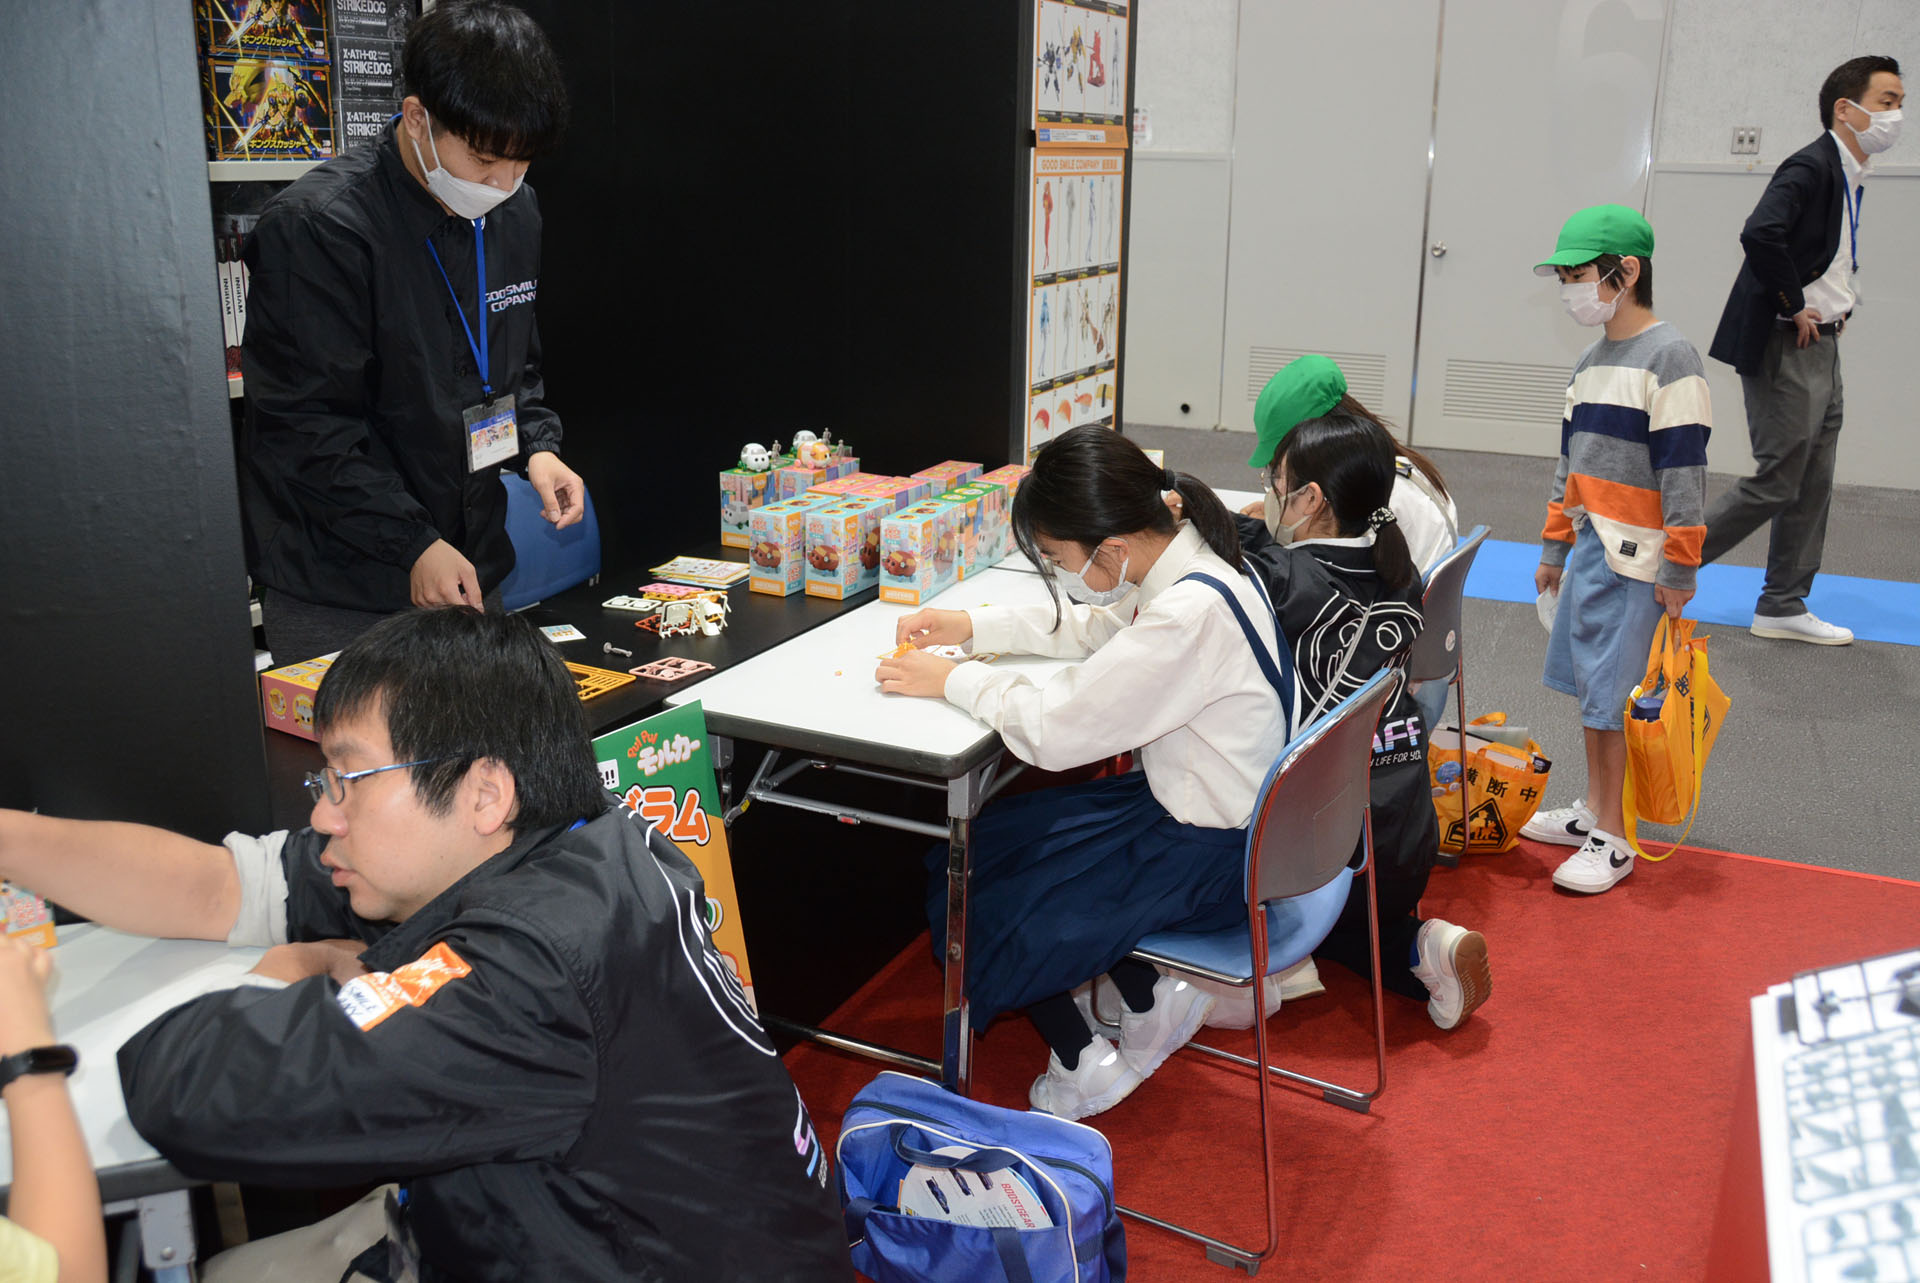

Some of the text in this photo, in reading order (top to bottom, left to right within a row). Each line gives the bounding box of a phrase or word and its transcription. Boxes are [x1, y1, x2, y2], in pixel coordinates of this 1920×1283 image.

[637, 733, 701, 777] モルカー
[1001, 1183, 1036, 1229] BOOSTGEAR
